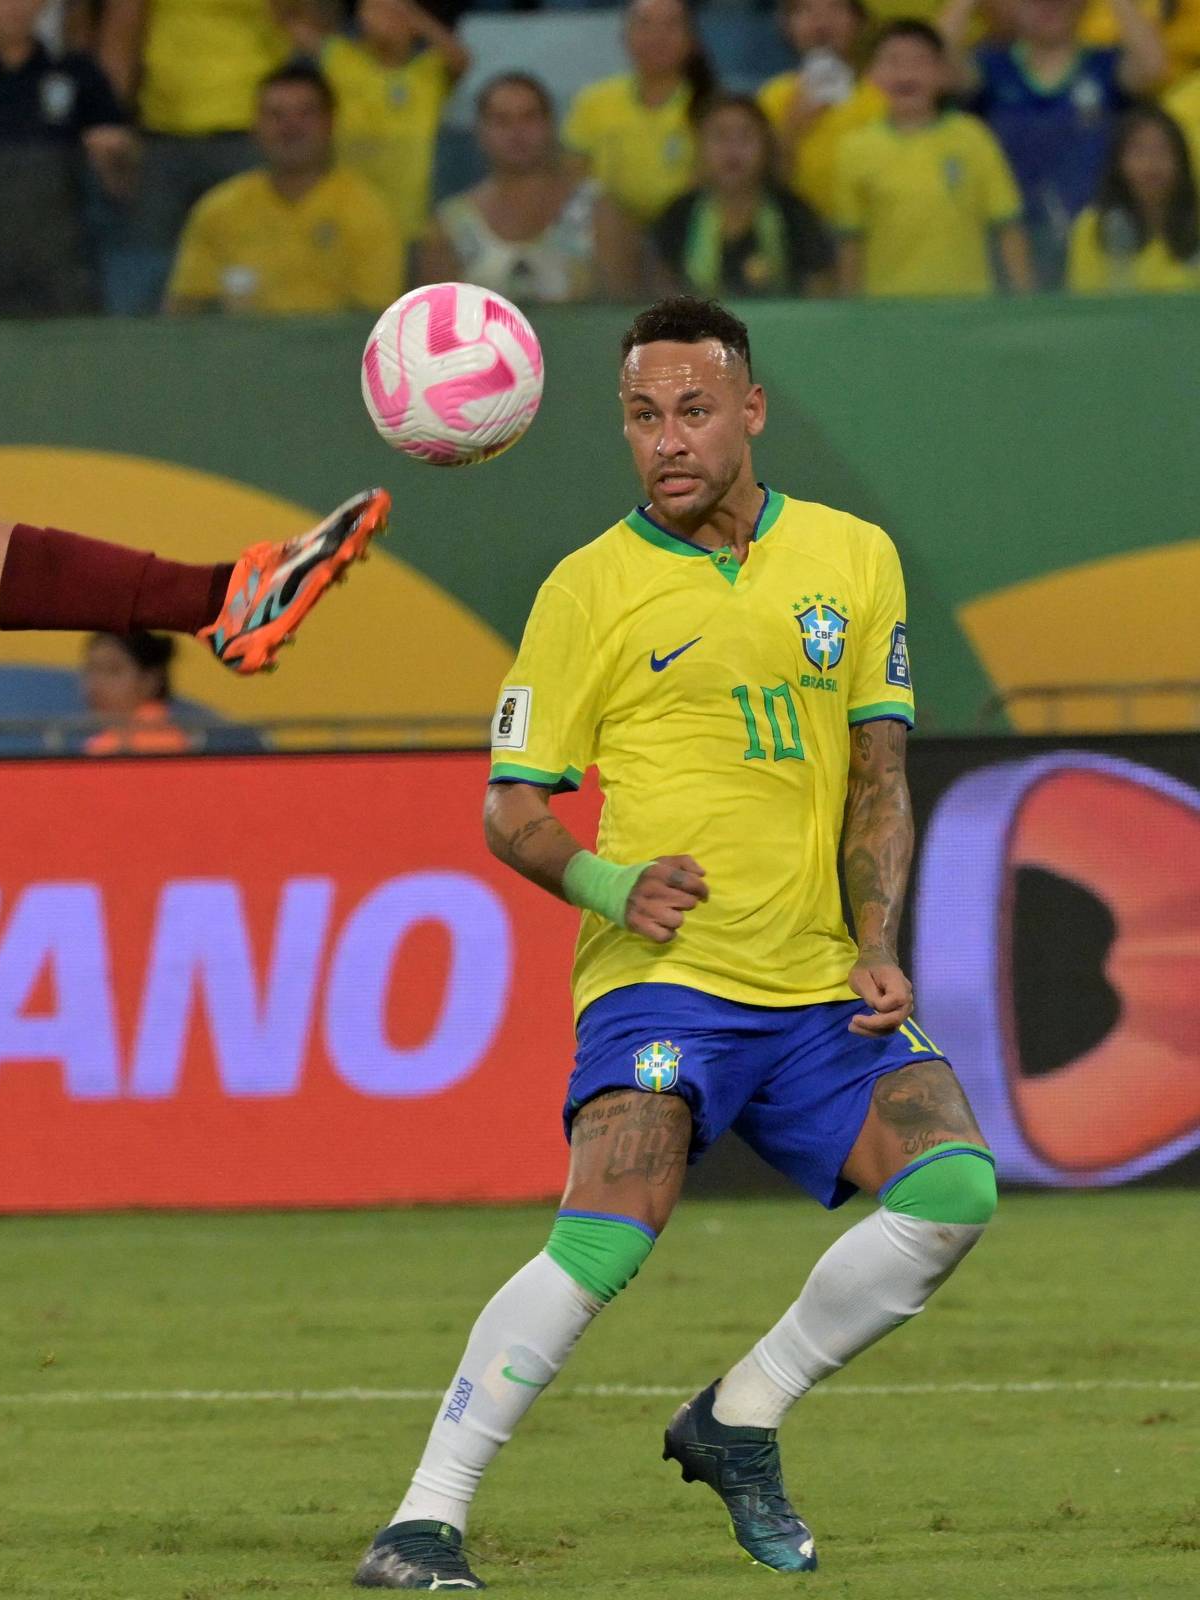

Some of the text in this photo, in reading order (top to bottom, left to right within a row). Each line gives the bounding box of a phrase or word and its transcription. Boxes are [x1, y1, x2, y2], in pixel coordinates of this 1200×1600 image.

[815, 630, 833, 640] CBF
[800, 674, 838, 692] BRASIL
[731, 682, 805, 762] 10
[648, 1061, 665, 1069] CBF
[443, 1377, 473, 1424] BRASIL
